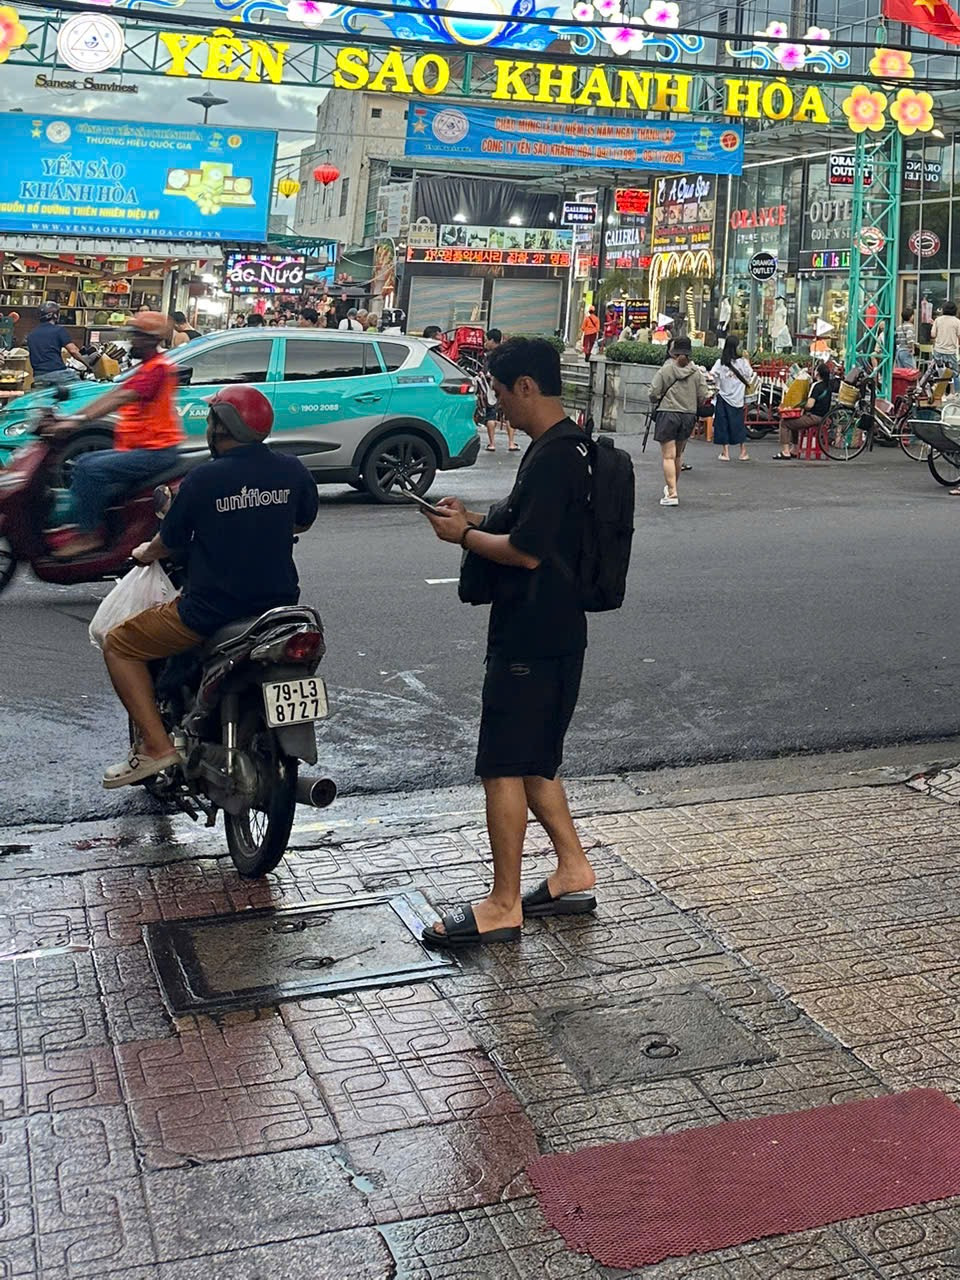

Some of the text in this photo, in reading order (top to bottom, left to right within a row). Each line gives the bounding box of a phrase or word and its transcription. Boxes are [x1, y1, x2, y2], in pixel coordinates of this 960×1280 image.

[35, 74, 78, 89] Sanest
[333, 45, 450, 95] SÀO
[724, 67, 830, 124] HÒA
[41, 152, 126, 180] YẾN SÀO
[19, 179, 139, 205] KHÁNH HÒA
[730, 205, 788, 229] ORANGE
[605, 228, 640, 247] GALLERIA
[273, 680, 317, 702] 79-L3
[276, 699, 319, 722] 8727
